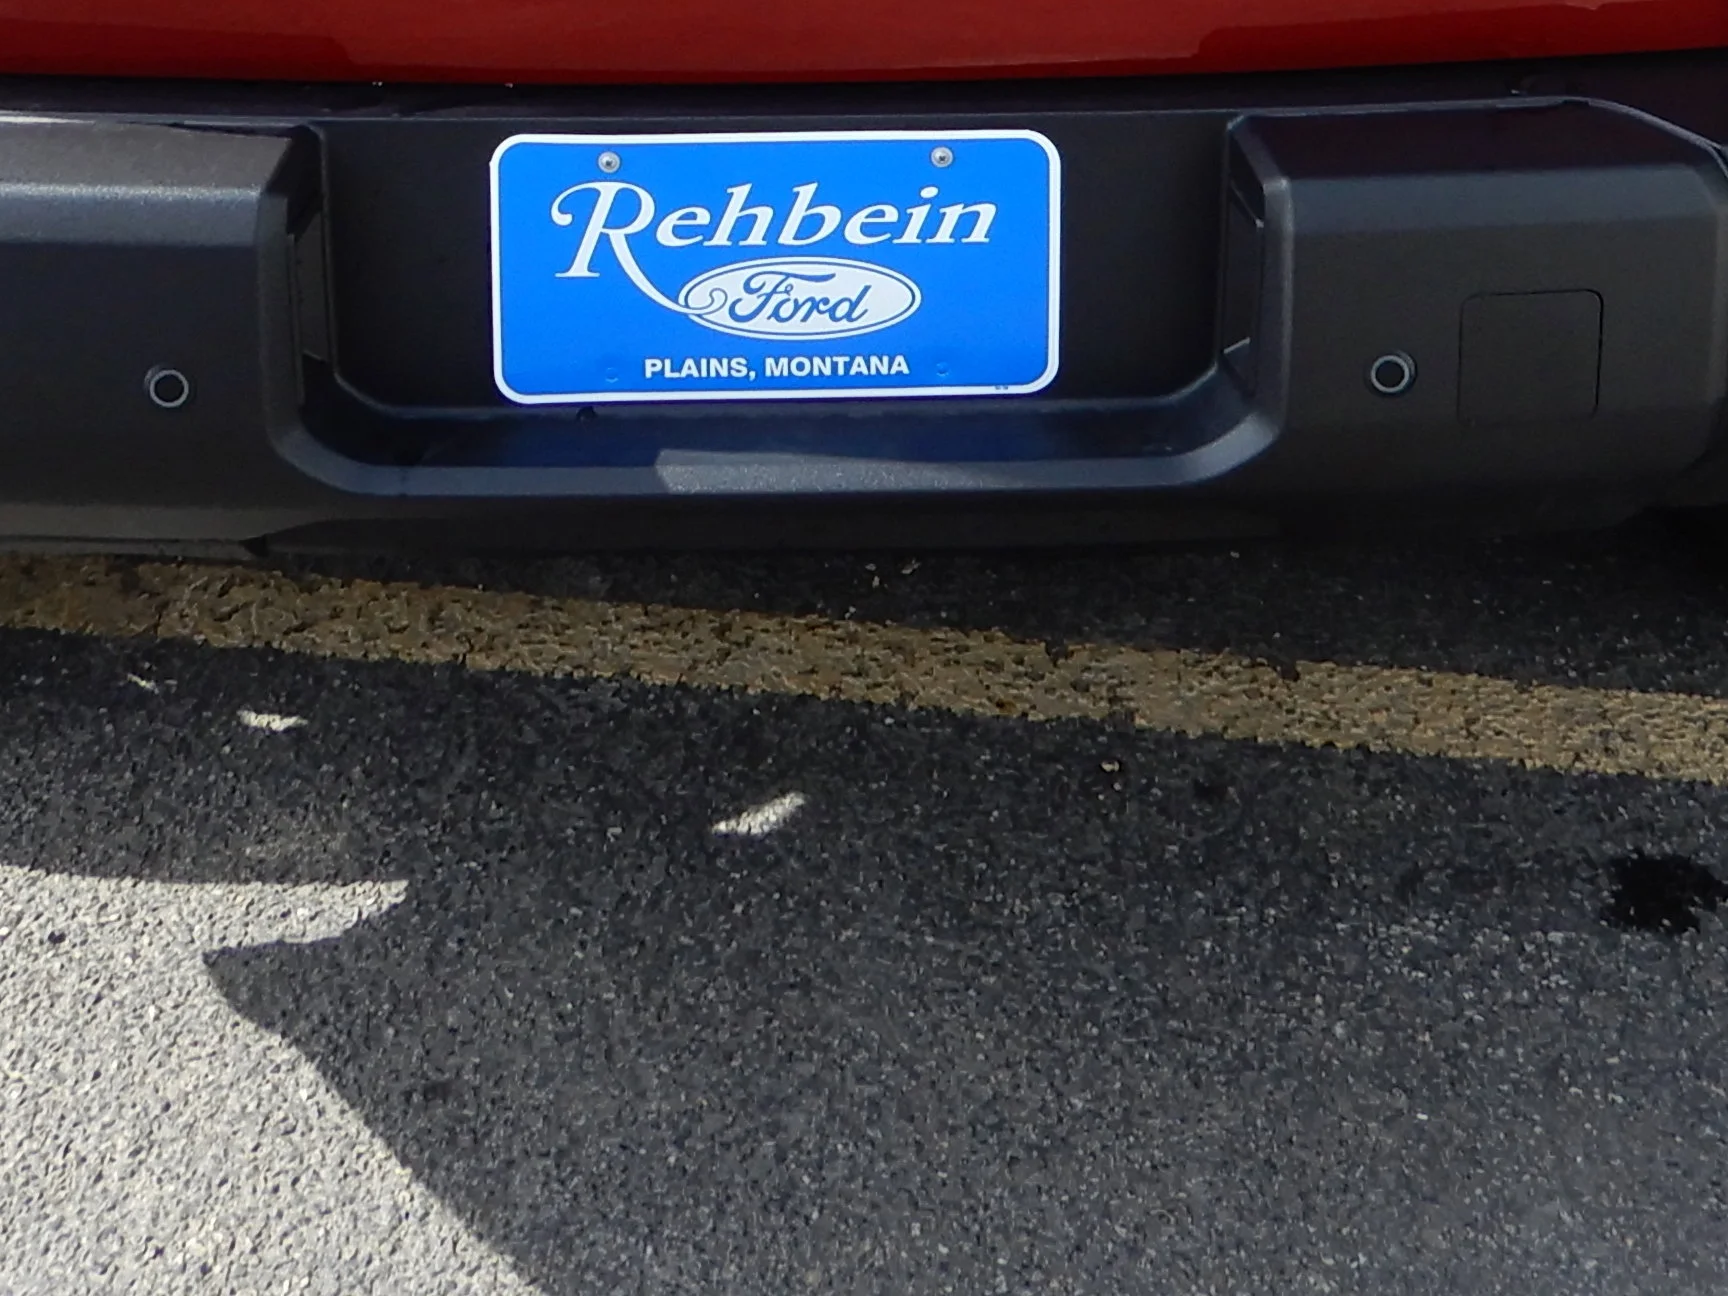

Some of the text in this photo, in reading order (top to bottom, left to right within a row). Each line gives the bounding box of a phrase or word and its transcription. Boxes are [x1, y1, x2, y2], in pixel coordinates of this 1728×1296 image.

[549, 180, 998, 308] Rehbein
[729, 270, 872, 323] Ford
[644, 354, 909, 382] PLAINS, MONTANA
